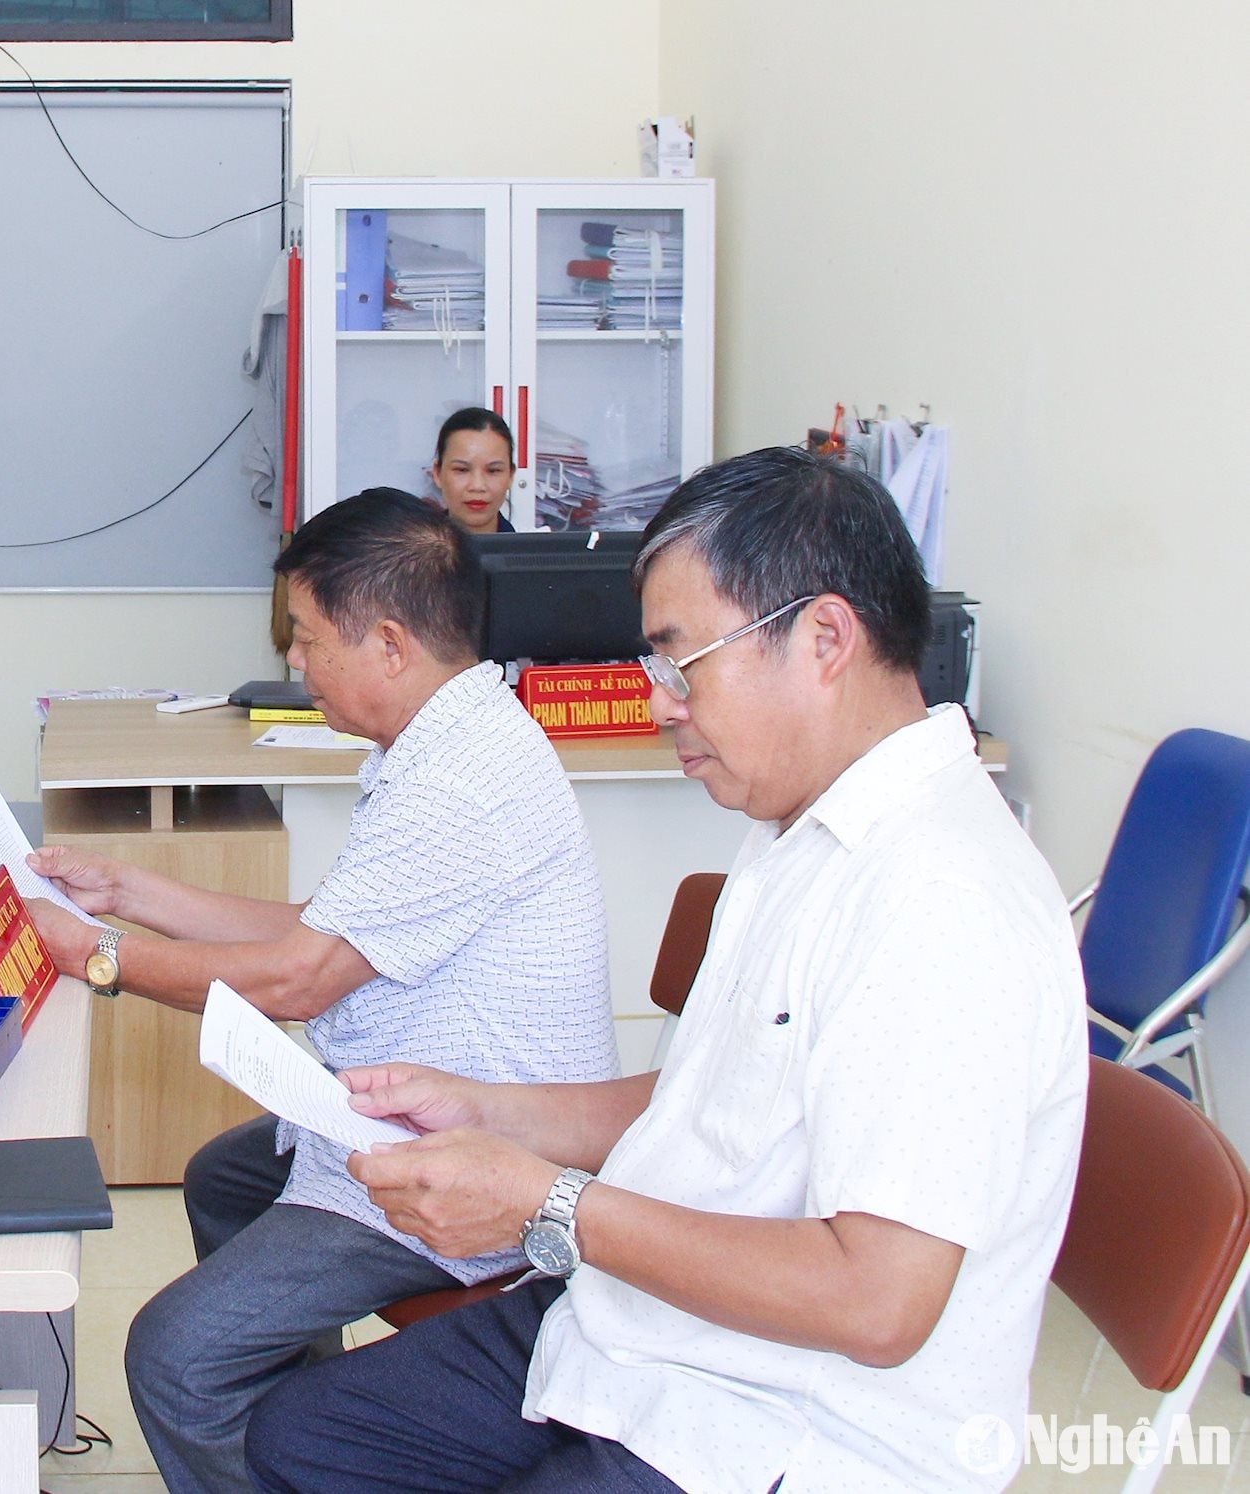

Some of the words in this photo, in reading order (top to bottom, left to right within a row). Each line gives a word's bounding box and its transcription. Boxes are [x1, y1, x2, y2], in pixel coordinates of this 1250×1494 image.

[537, 677, 555, 693] TÀI
[557, 676, 592, 692] CHÍNH
[600, 671, 615, 691] KẾ
[617, 673, 645, 690] TOÁN
[533, 701, 567, 728] PHAN
[570, 695, 609, 727] THÀNH
[612, 694, 651, 725] DUYÊN
